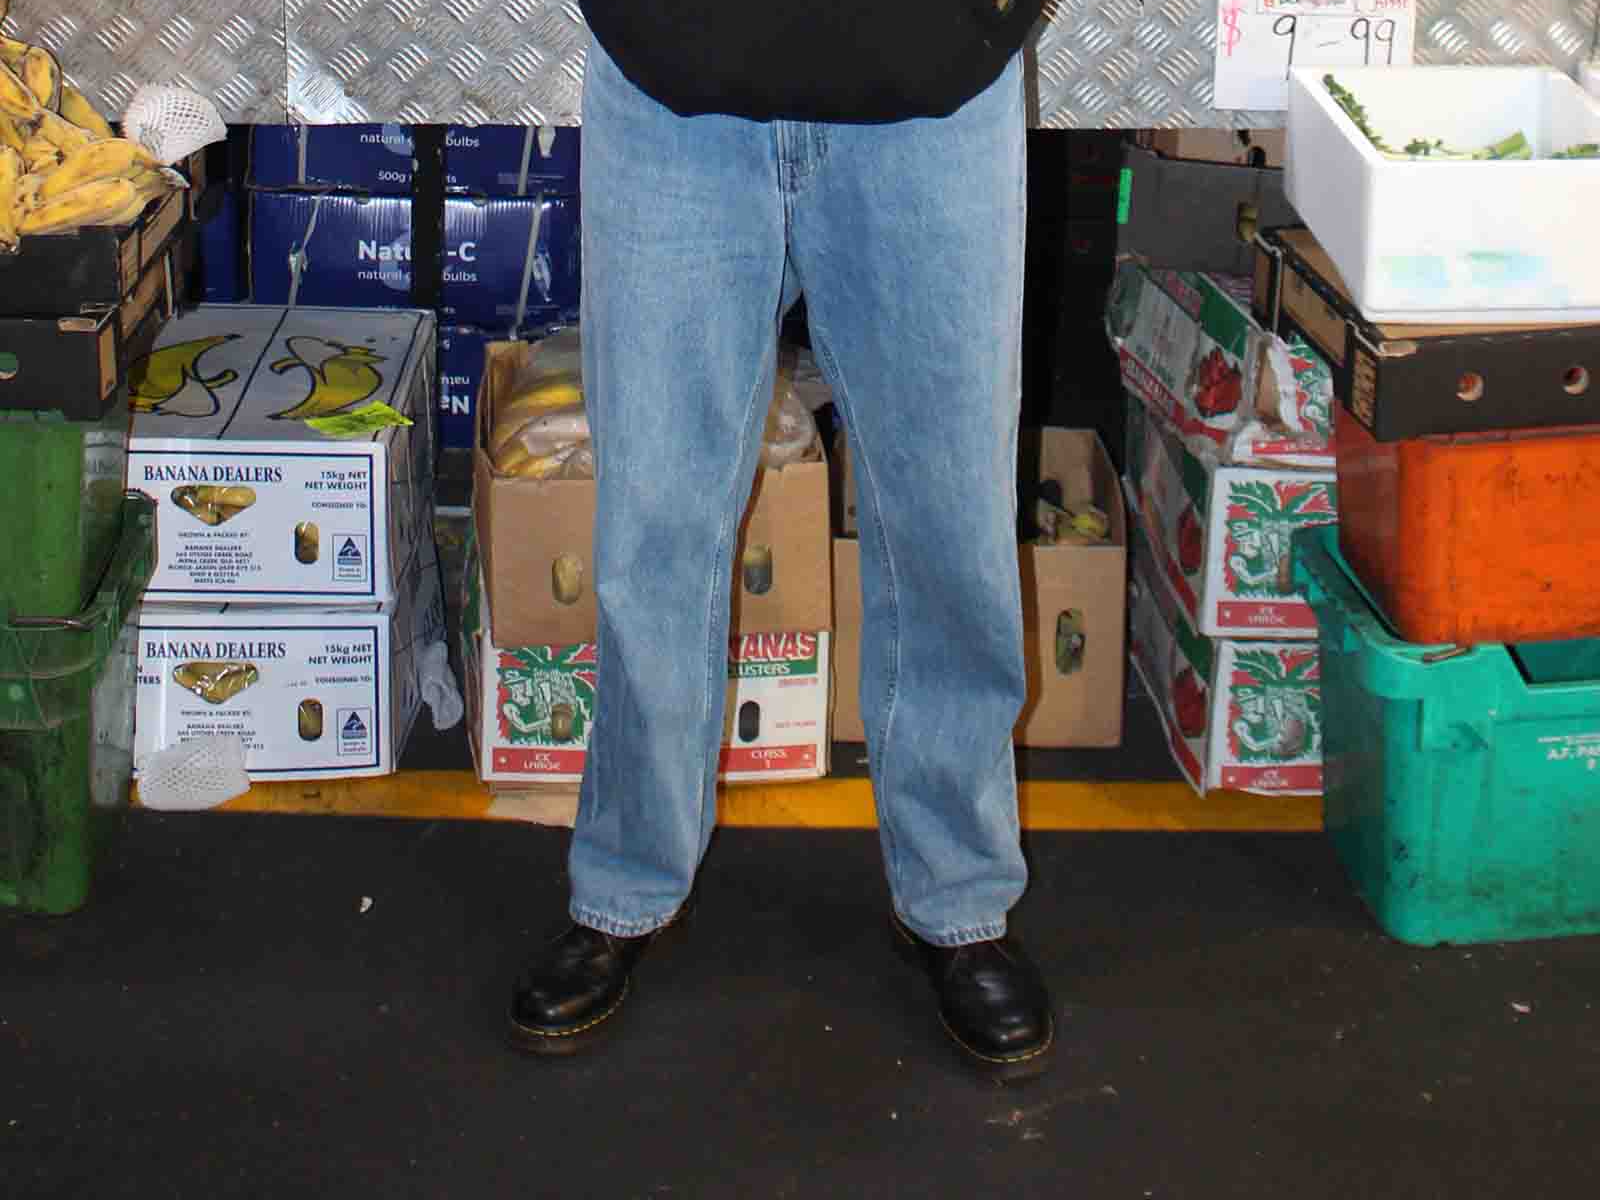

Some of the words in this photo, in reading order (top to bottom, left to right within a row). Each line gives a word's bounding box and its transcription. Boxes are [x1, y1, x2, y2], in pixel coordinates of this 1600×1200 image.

[446, 135, 480, 147] bulbs
[378, 170, 407, 184] 500g
[442, 270, 478, 282] bulbs
[144, 465, 209, 481] BANANA
[213, 466, 283, 483] DEALERS
[320, 471, 346, 481] 15kg
[348, 471, 367, 481] NET
[304, 481, 325, 490] NET
[327, 481, 368, 491] WEIGHT
[147, 642, 211, 658] BANANA
[216, 642, 286, 659] DEALERS
[325, 645, 350, 655] 15kg
[353, 644, 371, 654] NET
[308, 656, 329, 665] NET
[331, 655, 372, 665] WEIGHT
